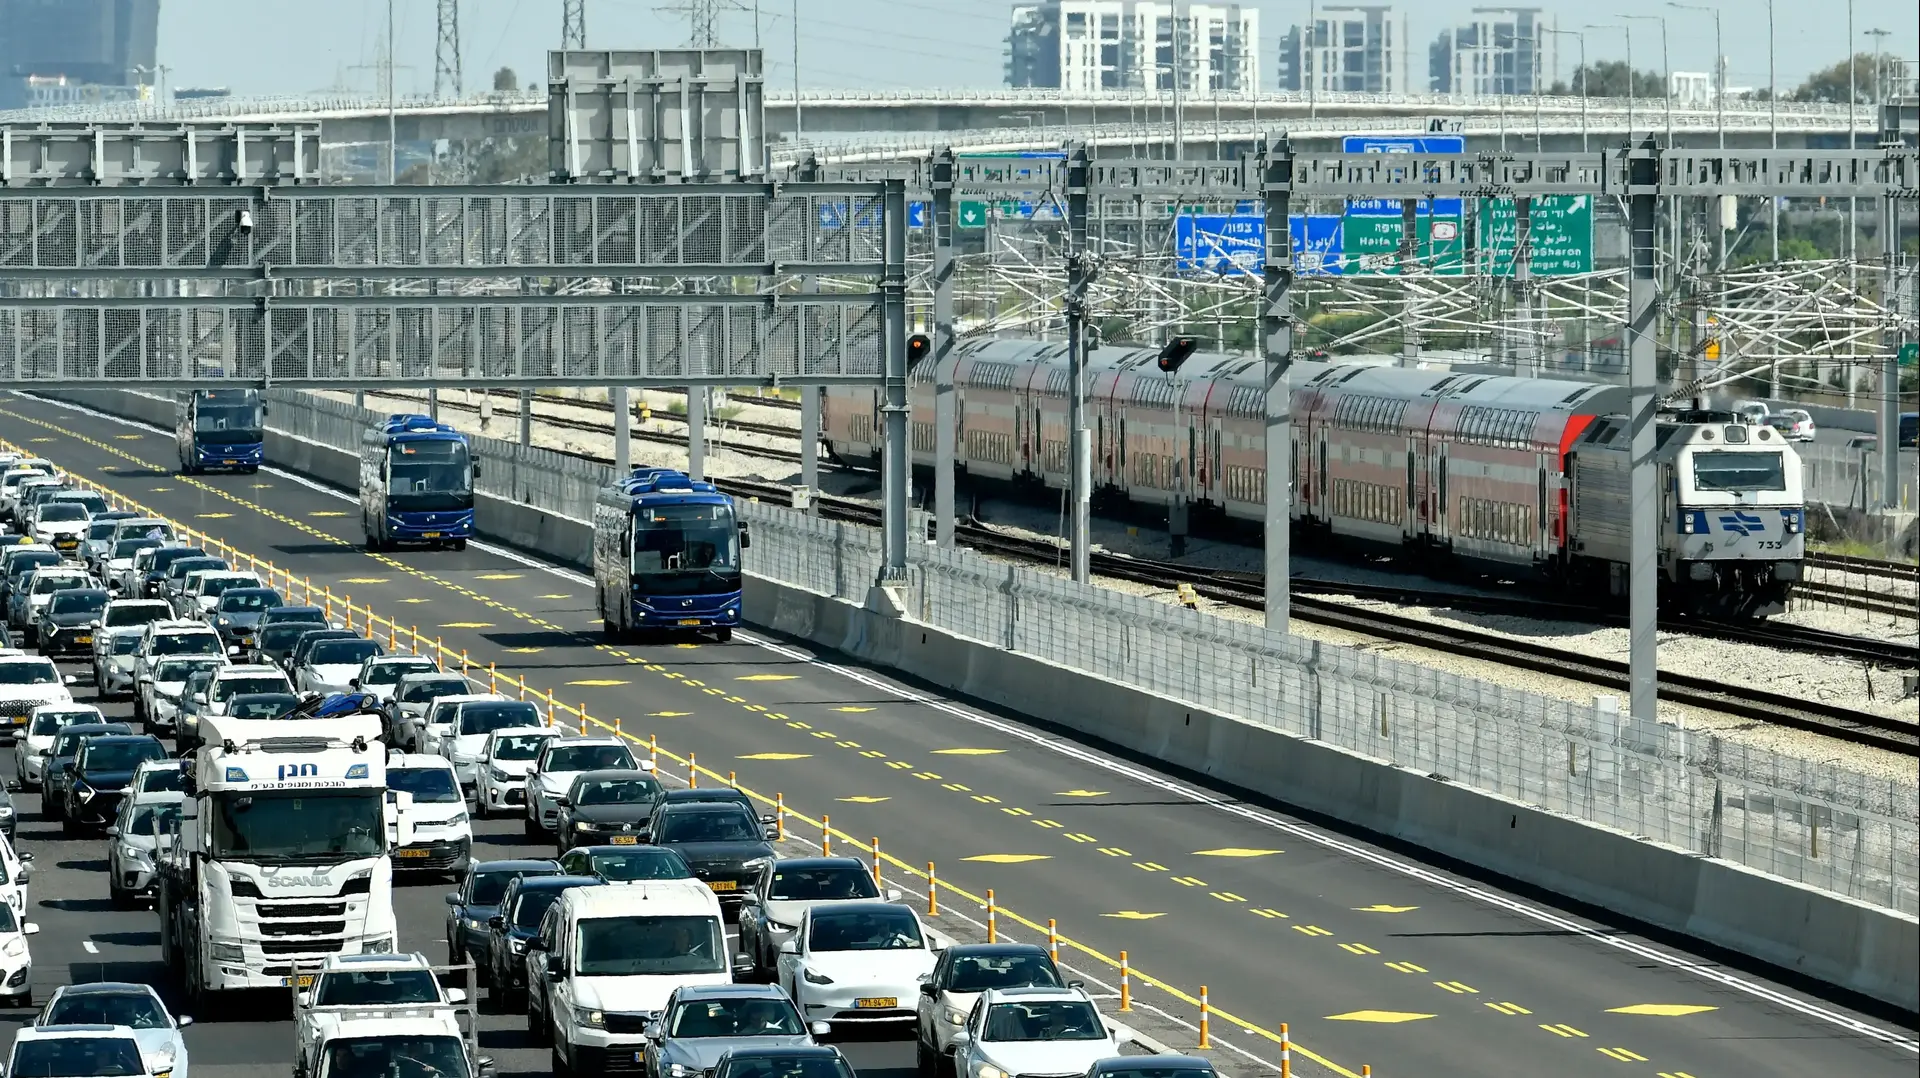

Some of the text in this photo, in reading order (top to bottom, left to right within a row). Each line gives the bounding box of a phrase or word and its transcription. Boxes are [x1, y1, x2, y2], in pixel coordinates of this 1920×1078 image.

[1450, 122, 1462, 132] 17
[1757, 541, 1782, 550] 733
[278, 763, 318, 781] חנן
[314, 780, 346, 788] הובלות
[268, 875, 332, 888] SCANIA
